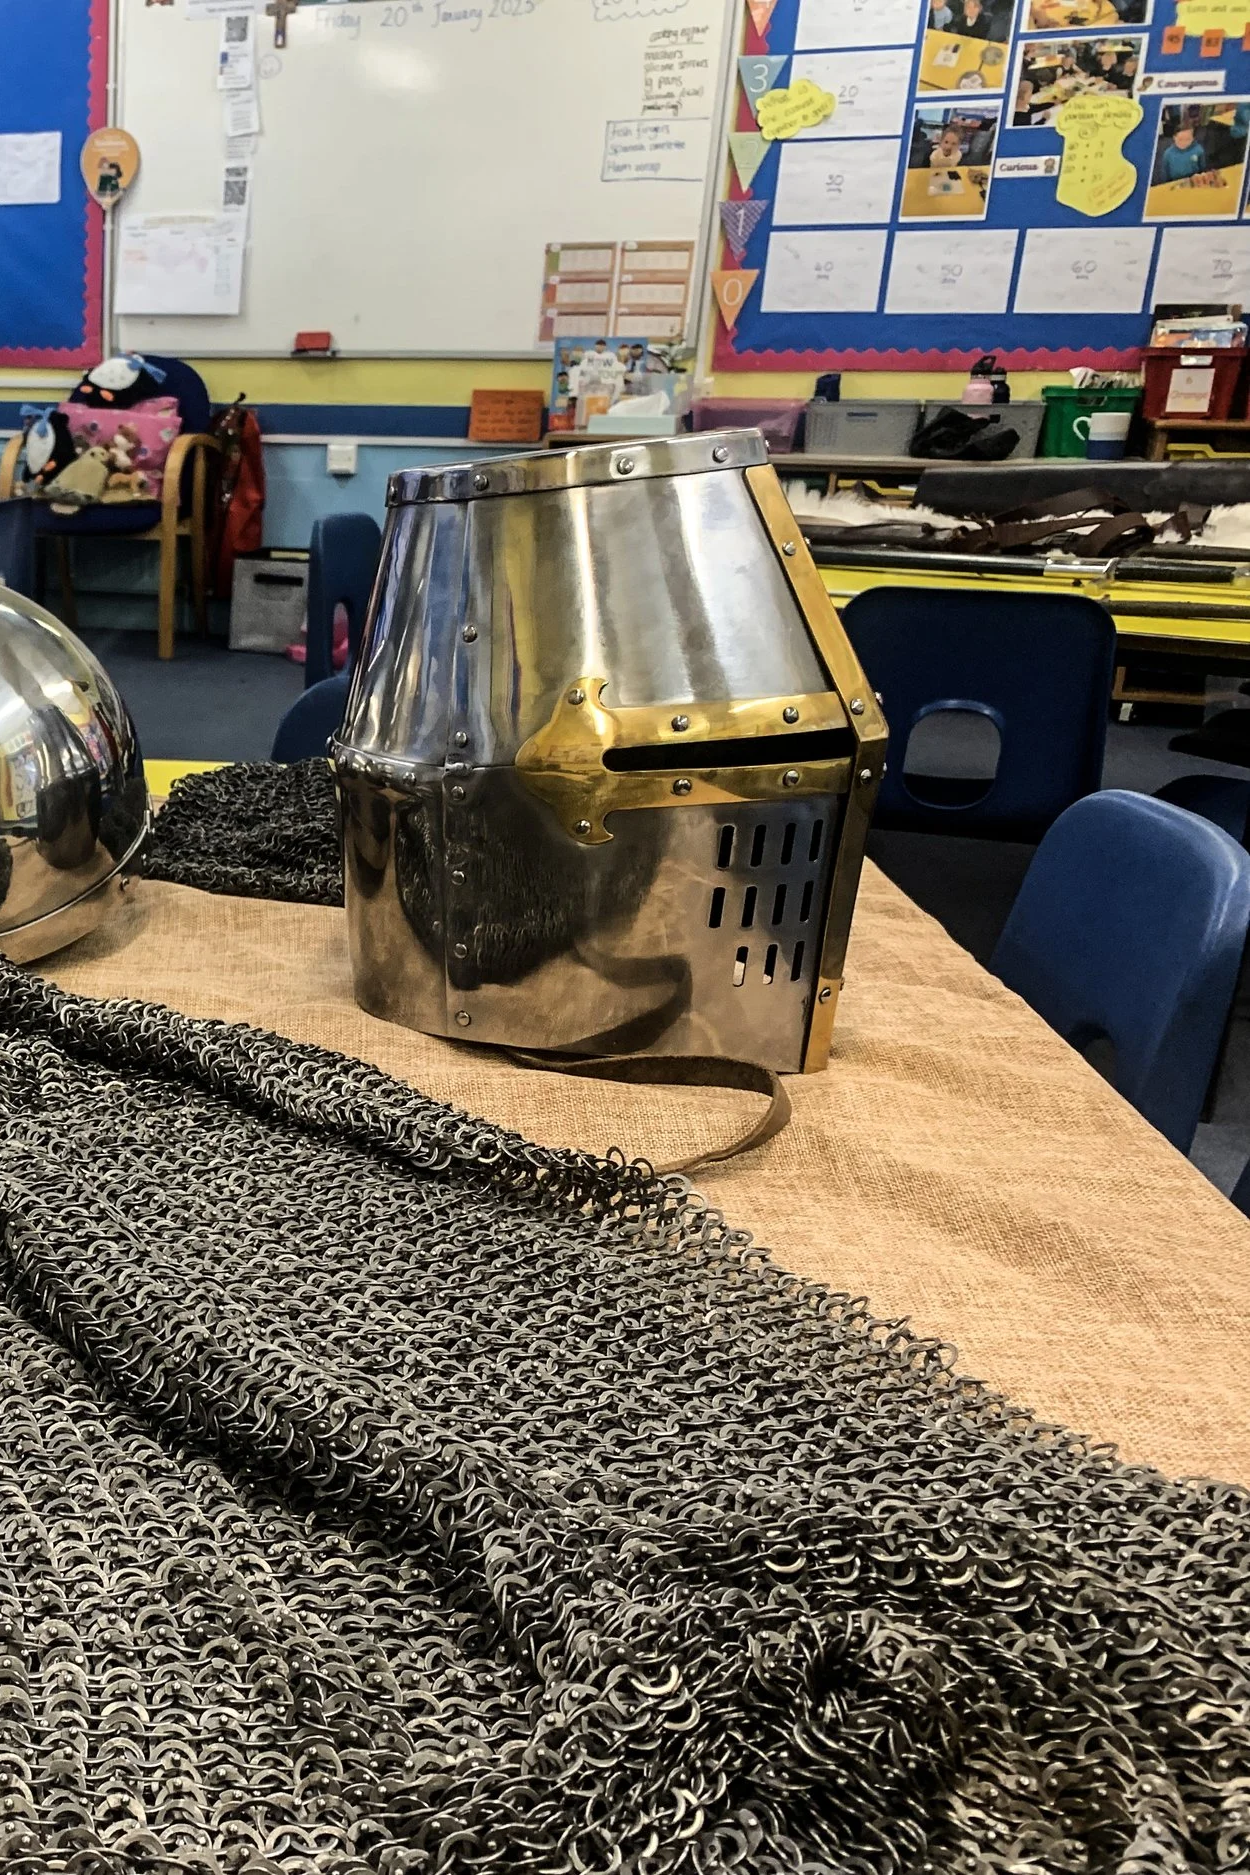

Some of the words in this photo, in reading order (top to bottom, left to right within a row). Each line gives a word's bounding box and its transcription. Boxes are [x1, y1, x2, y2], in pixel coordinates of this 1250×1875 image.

[431, 0, 483, 33] January
[750, 63, 769, 93] 3
[838, 85, 859, 98] 20
[1000, 163, 1038, 172] Curious
[737, 209, 745, 236] 1
[941, 264, 963, 277] 50
[1072, 260, 1097, 274] 60
[1212, 259, 1233, 273] 70
[723, 278, 743, 306] 0
